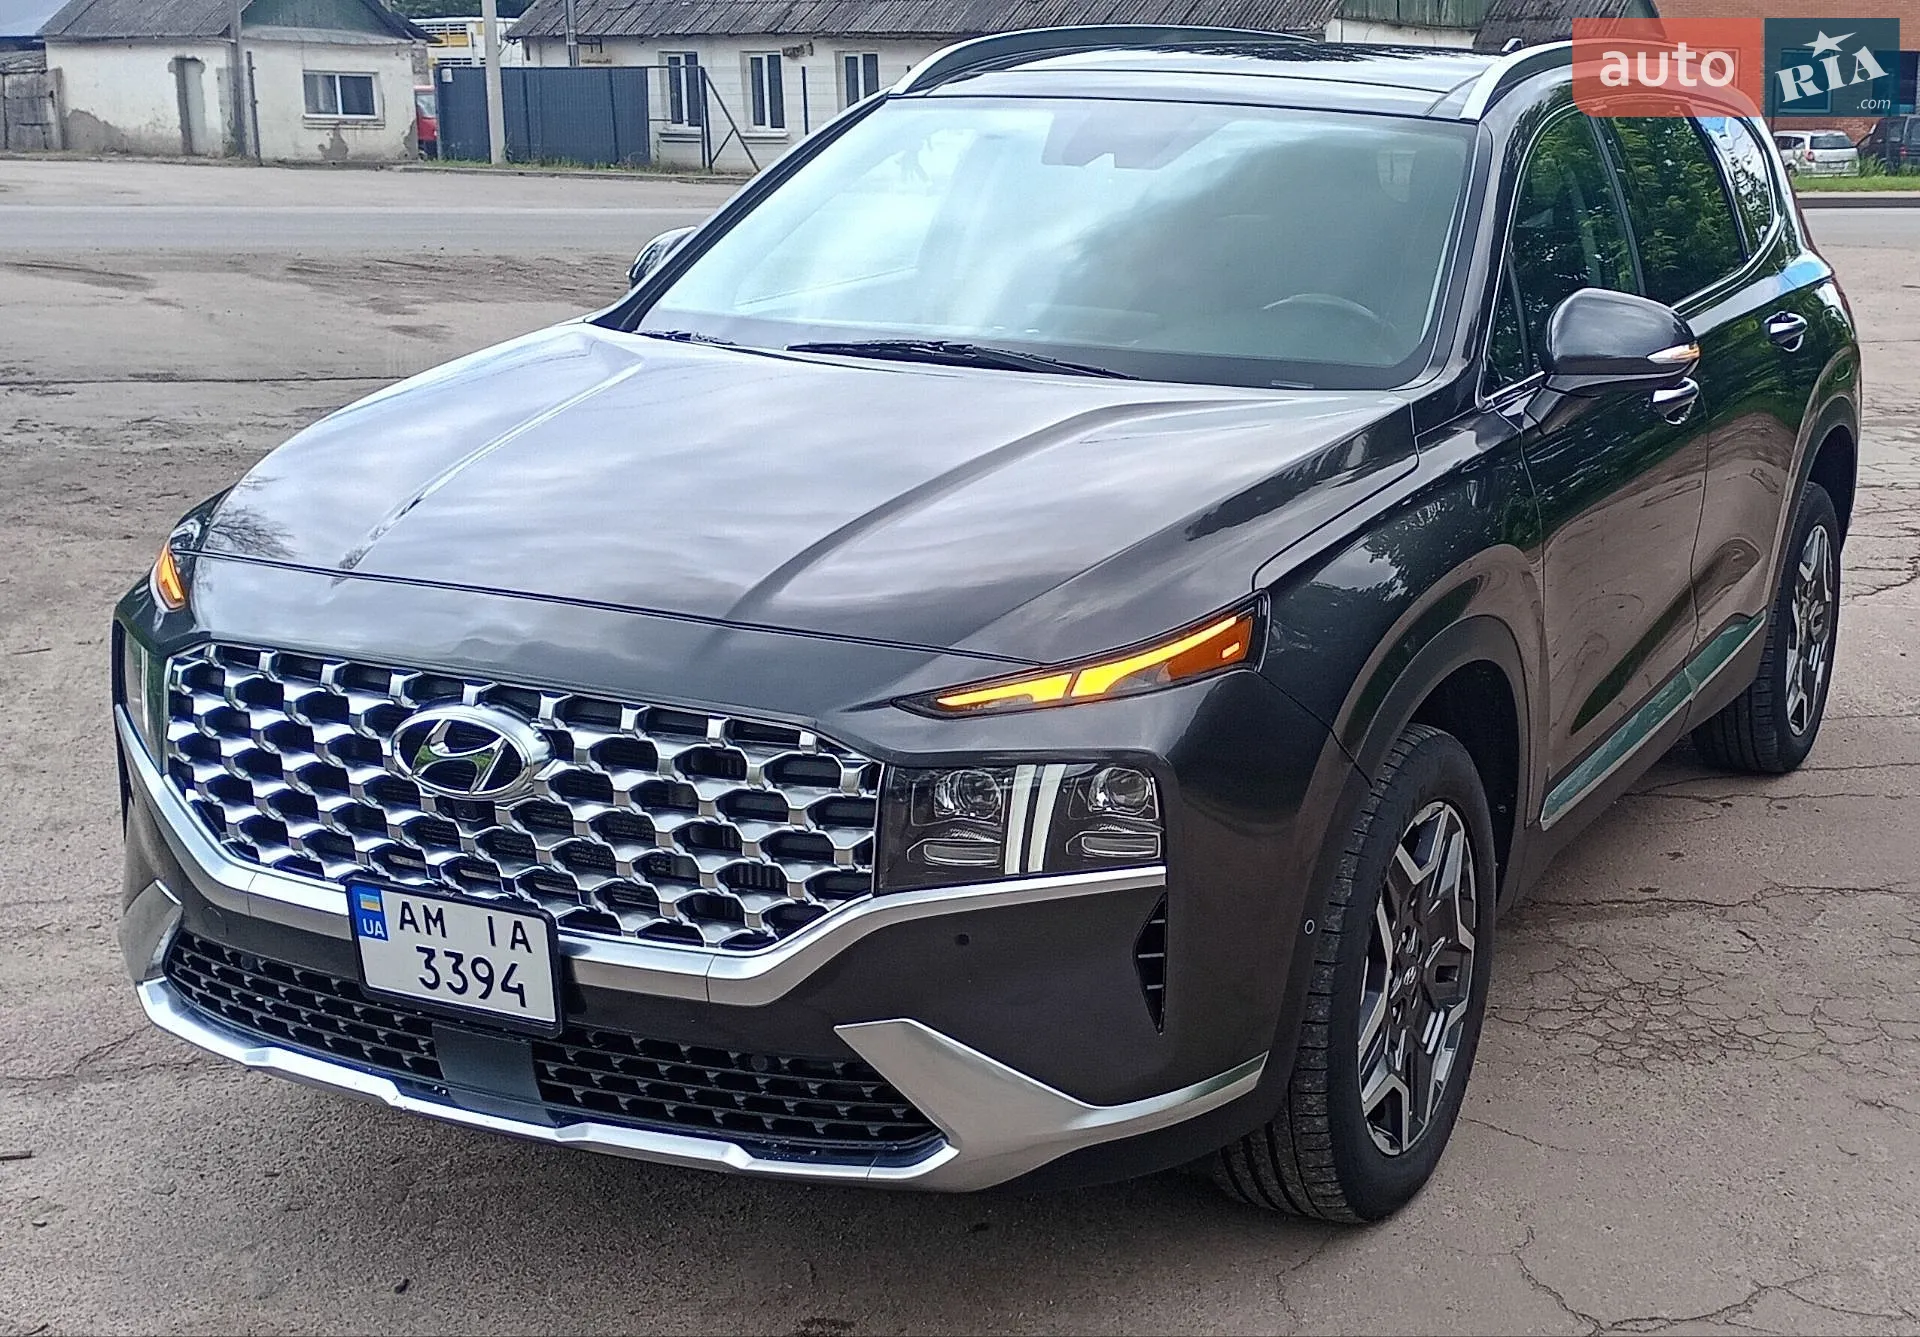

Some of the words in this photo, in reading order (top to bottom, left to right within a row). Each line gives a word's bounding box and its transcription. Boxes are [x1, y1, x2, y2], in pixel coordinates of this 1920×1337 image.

[362, 918, 385, 938] UA
[399, 901, 447, 938] AM
[487, 915, 532, 953] IA
[416, 945, 526, 1008] 3394
